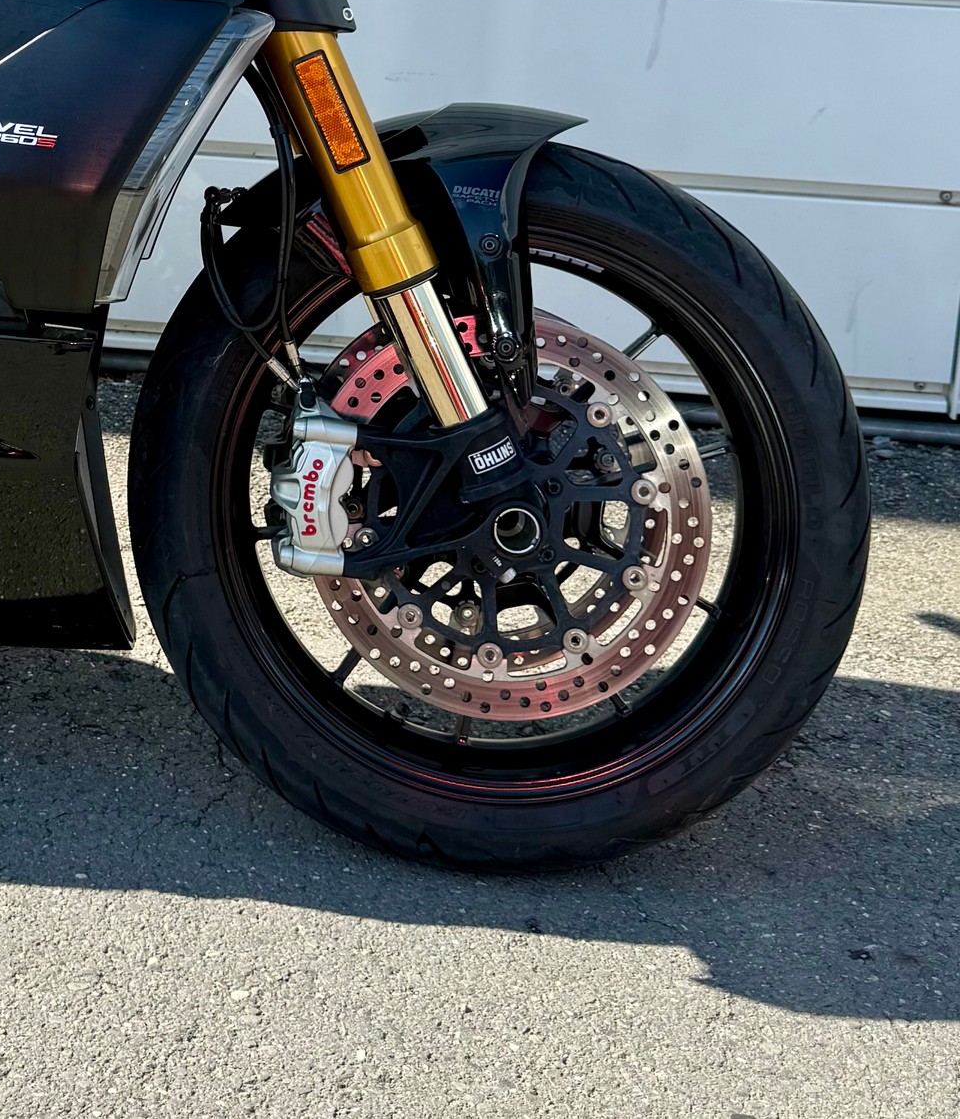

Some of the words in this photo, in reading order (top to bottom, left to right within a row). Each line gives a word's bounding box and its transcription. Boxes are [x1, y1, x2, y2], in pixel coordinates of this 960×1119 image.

[452, 185, 500, 199] DUCATI
[472, 440, 515, 471] ÖHLINS
[301, 458, 325, 537] brembo
